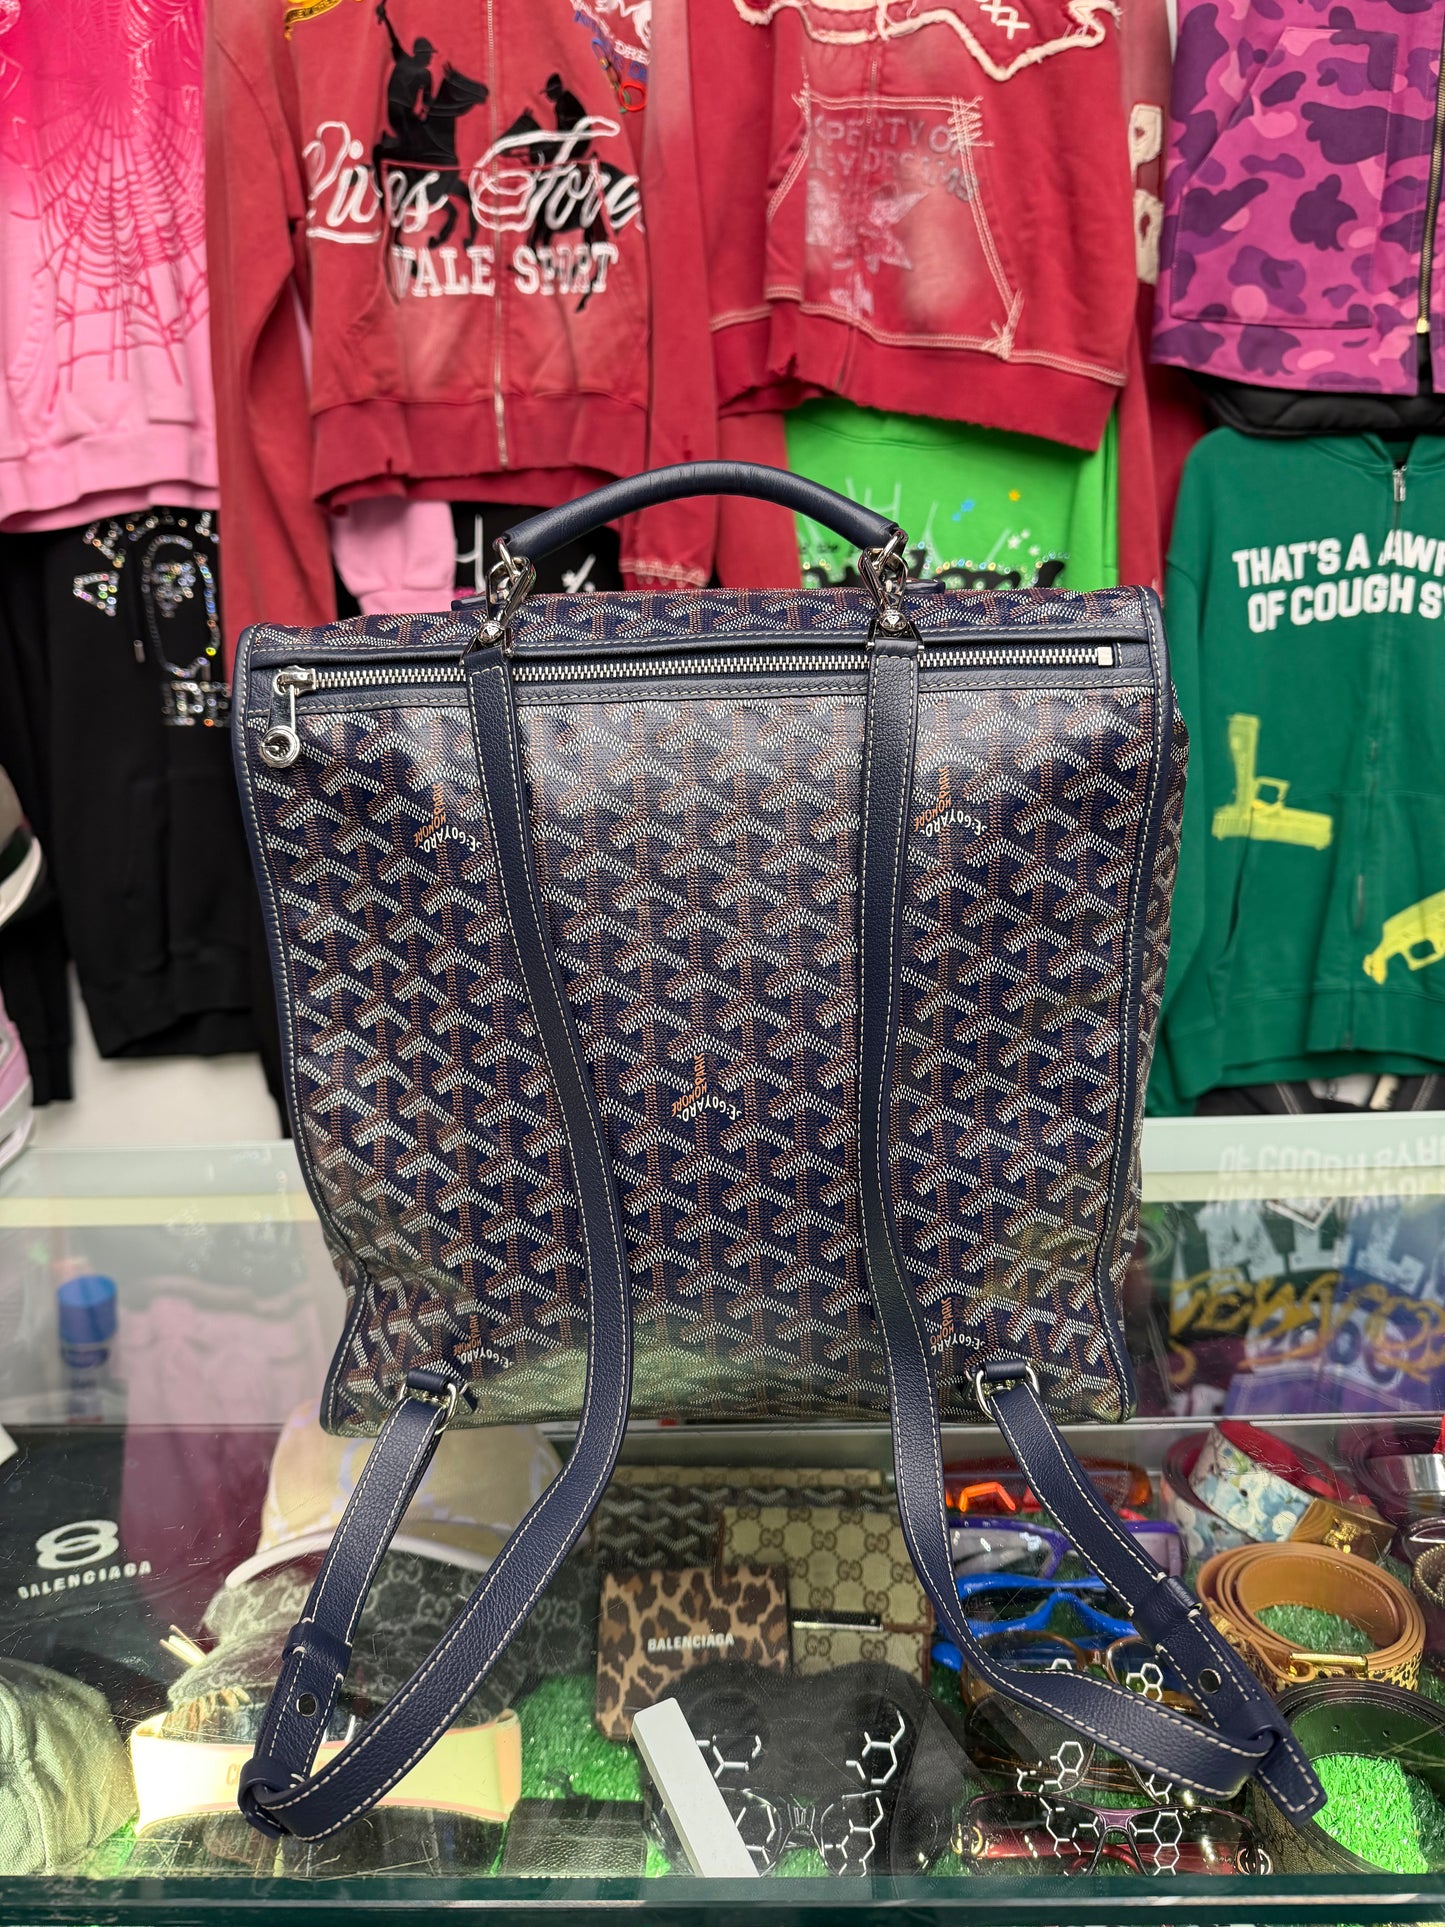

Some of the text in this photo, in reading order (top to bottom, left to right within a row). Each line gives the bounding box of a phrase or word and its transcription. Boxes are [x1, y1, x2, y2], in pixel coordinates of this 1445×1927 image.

[391, 241, 619, 298] VALE SPORT
[1232, 537, 1342, 588] THAT'S
[1345, 532, 1371, 572] A
[1248, 573, 1445, 634] OF COUGH S
[17, 1559, 152, 1601] BALENCIAGA
[647, 1631, 736, 1654] BALENCIAGA
